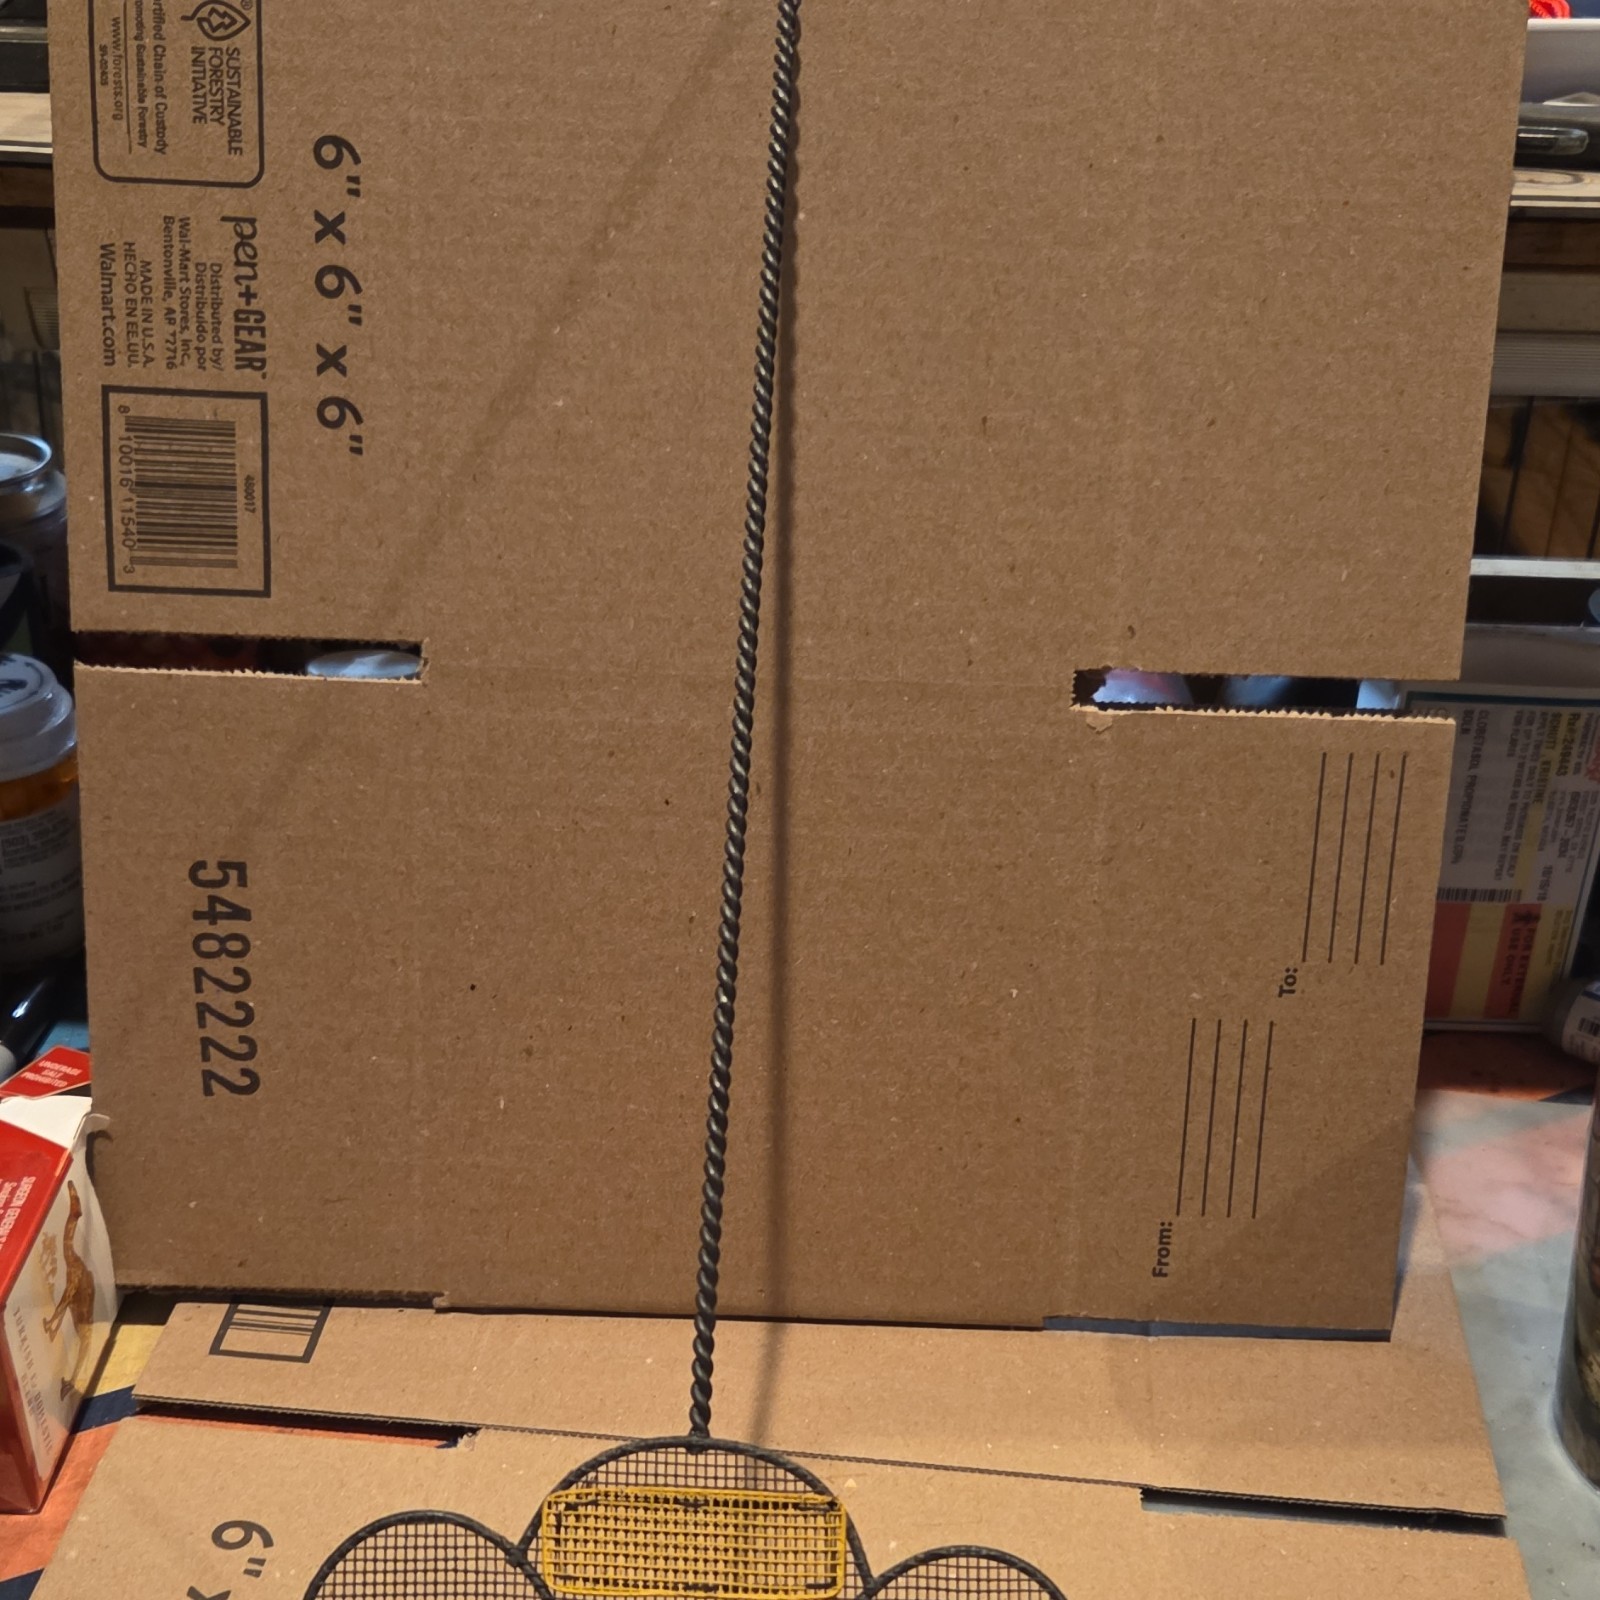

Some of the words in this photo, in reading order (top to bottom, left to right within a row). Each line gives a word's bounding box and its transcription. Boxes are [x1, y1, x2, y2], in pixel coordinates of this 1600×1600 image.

[152, 0, 166, 41] rtified
[111, 16, 123, 121] www.forests.org
[136, 44, 148, 104] Sustainable
[153, 44, 166, 83] Chain
[190, 46, 208, 125] INITIATIVE
[208, 47, 226, 126] FORESTRY
[154, 86, 167, 100] of
[225, 46, 243, 156] SUSTAINABLE
[137, 107, 149, 148] Forestry
[154, 102, 169, 155] Custody
[313, 134, 362, 198] 6"
[179, 216, 191, 283] Wal-Mart
[314, 209, 346, 246] x
[123, 241, 137, 295] HECHO
[139, 260, 152, 305] MADE
[163, 215, 176, 302] Bentonville,
[100, 242, 117, 367] Walmart.com
[125, 298, 138, 318] EN
[141, 308, 153, 324] IN
[179, 286, 191, 334] Stores,
[195, 263, 208, 344] Distribuido
[210, 263, 223, 344] Distributed
[314, 264, 363, 326] 6"
[141, 328, 155, 368] U.S.A.
[194, 346, 207, 371] por
[210, 348, 224, 372] by/
[316, 342, 347, 378] x
[316, 395, 364, 456] 6"
[188, 860, 261, 1097] 5482222
[1277, 966, 1299, 998] To:
[1152, 1221, 1173, 1279] From:
[211, 1520, 274, 1578] 6"
